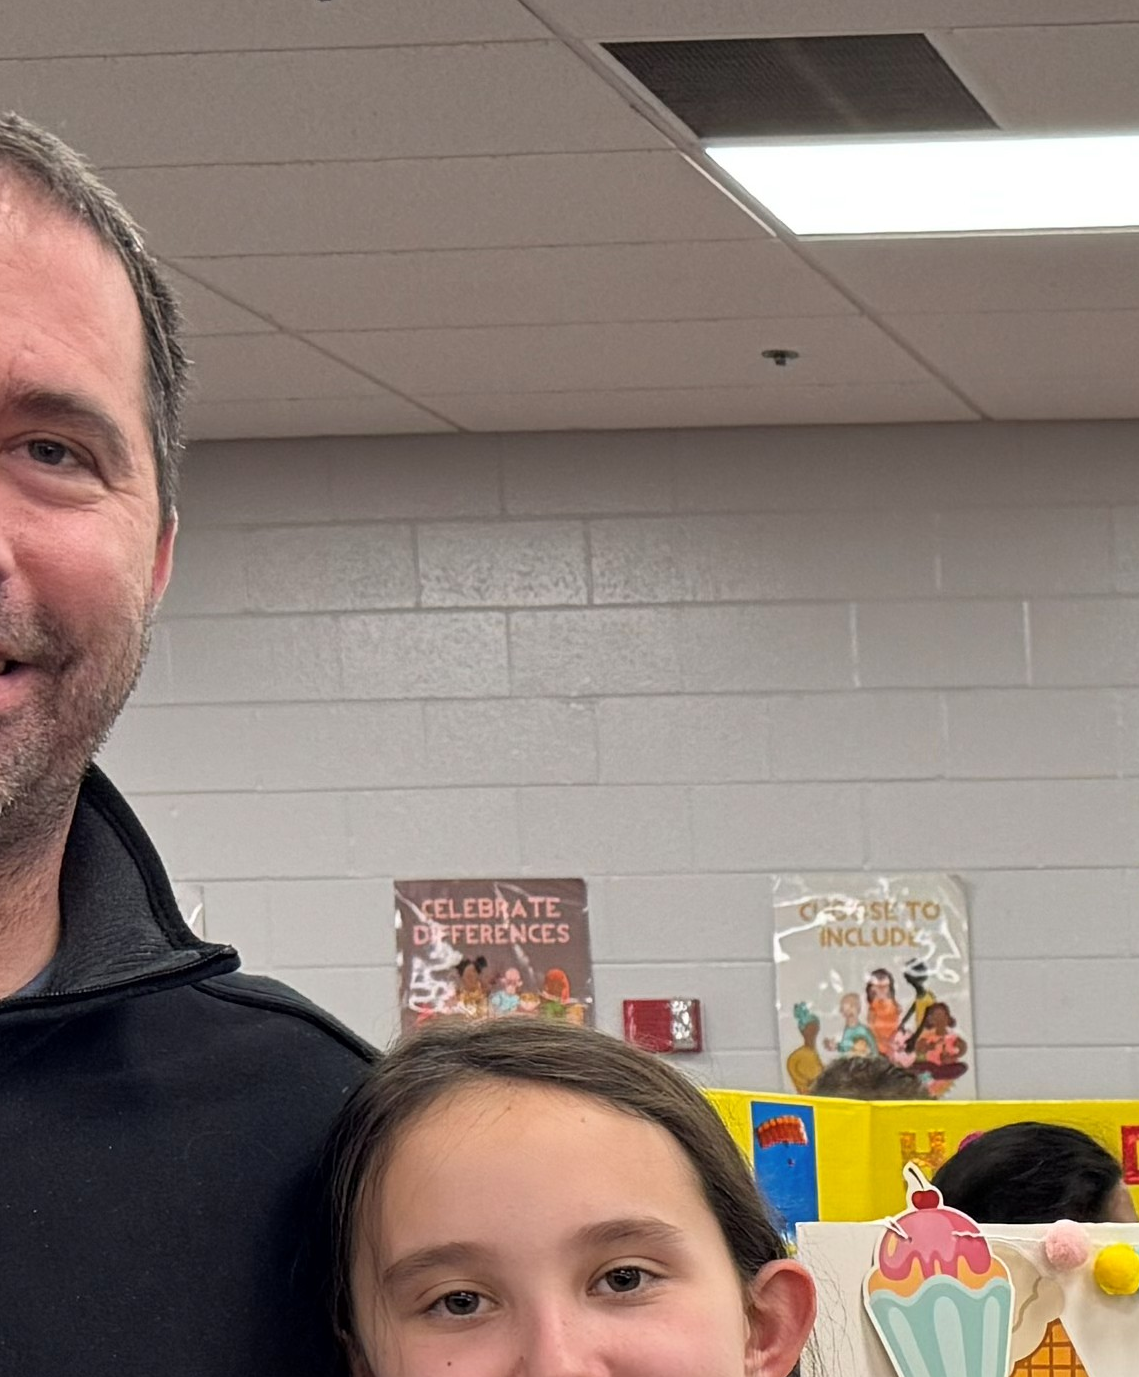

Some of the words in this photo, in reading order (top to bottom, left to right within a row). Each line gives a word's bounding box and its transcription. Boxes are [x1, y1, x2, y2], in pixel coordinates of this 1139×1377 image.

[421, 896, 561, 919] CELEBRATE
[906, 900, 941, 921] TO
[413, 924, 570, 946] DIFFERENCES
[820, 927, 920, 948] INCLUDE
